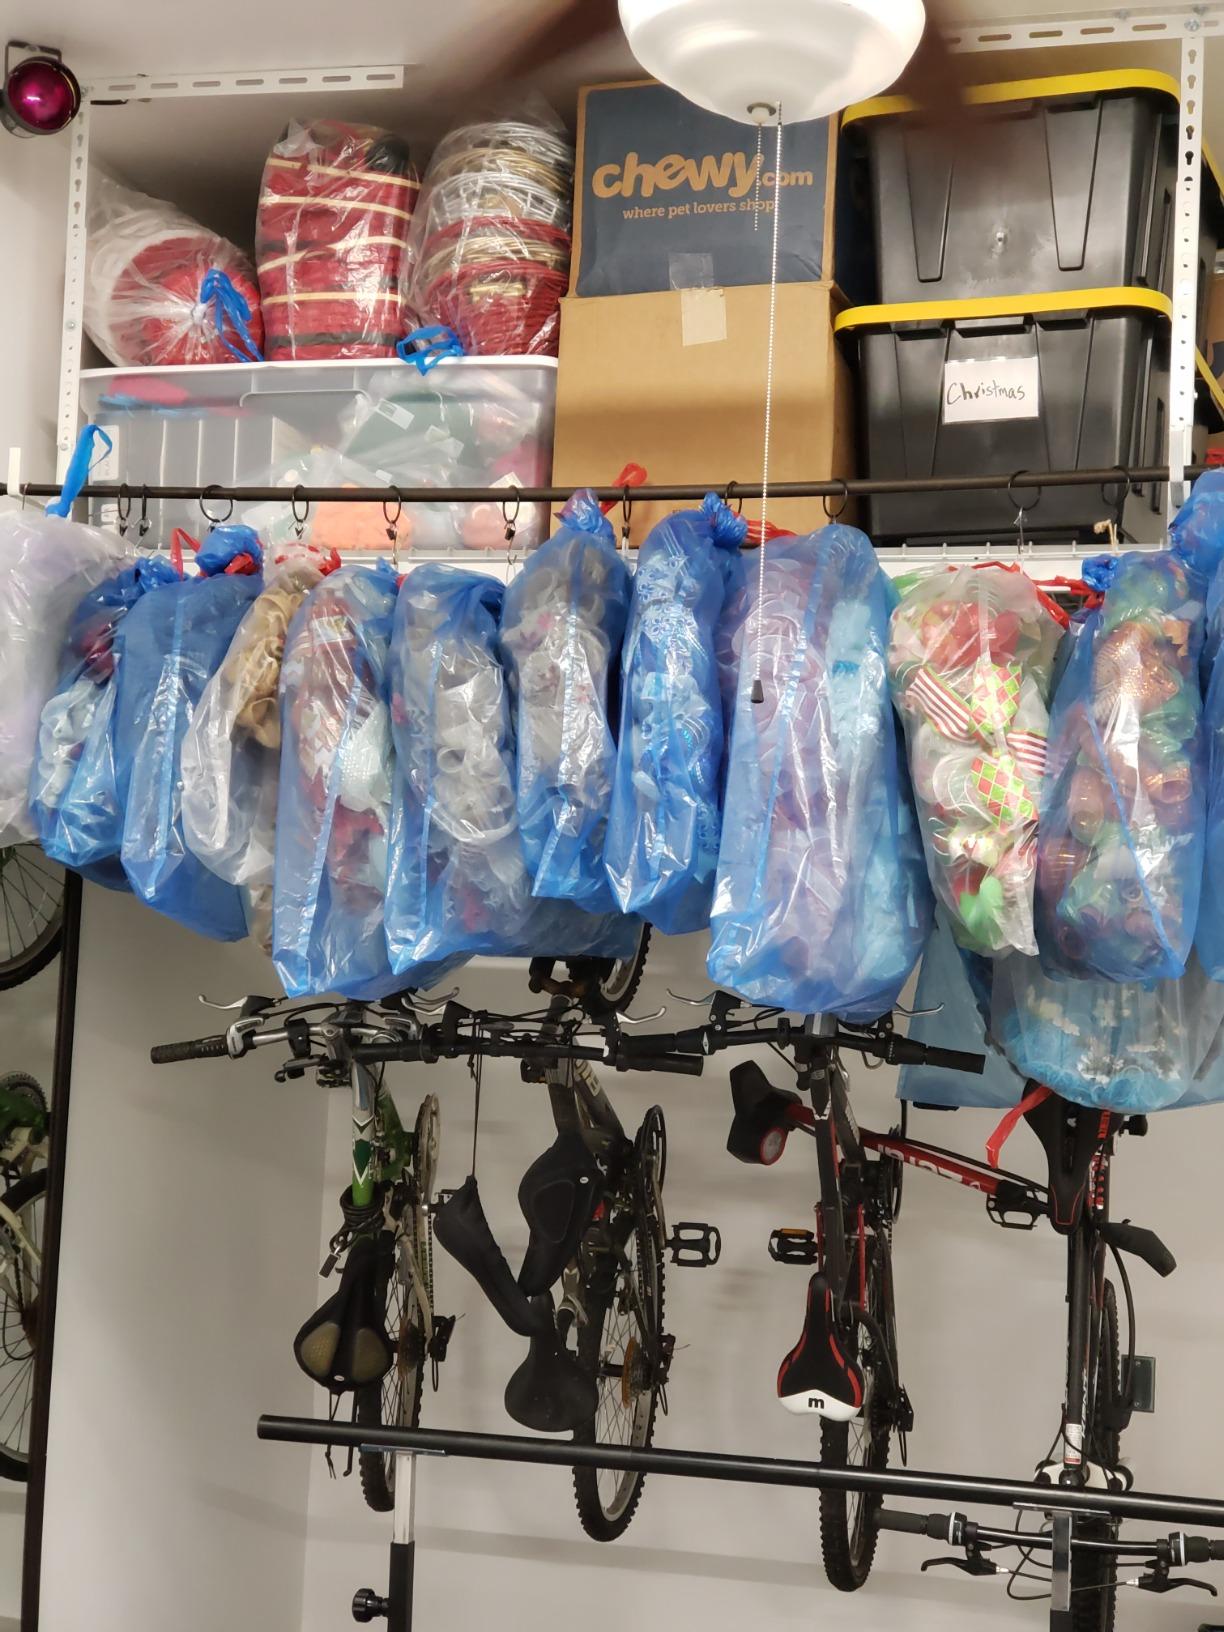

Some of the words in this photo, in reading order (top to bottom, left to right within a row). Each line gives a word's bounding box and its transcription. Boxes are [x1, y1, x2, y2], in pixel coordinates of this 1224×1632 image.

[623, 206, 665, 219] where
[667, 203, 690, 219] pet
[693, 201, 736, 215] lovers
[739, 198, 775, 214] shop
[946, 380, 1026, 405] Christmas
